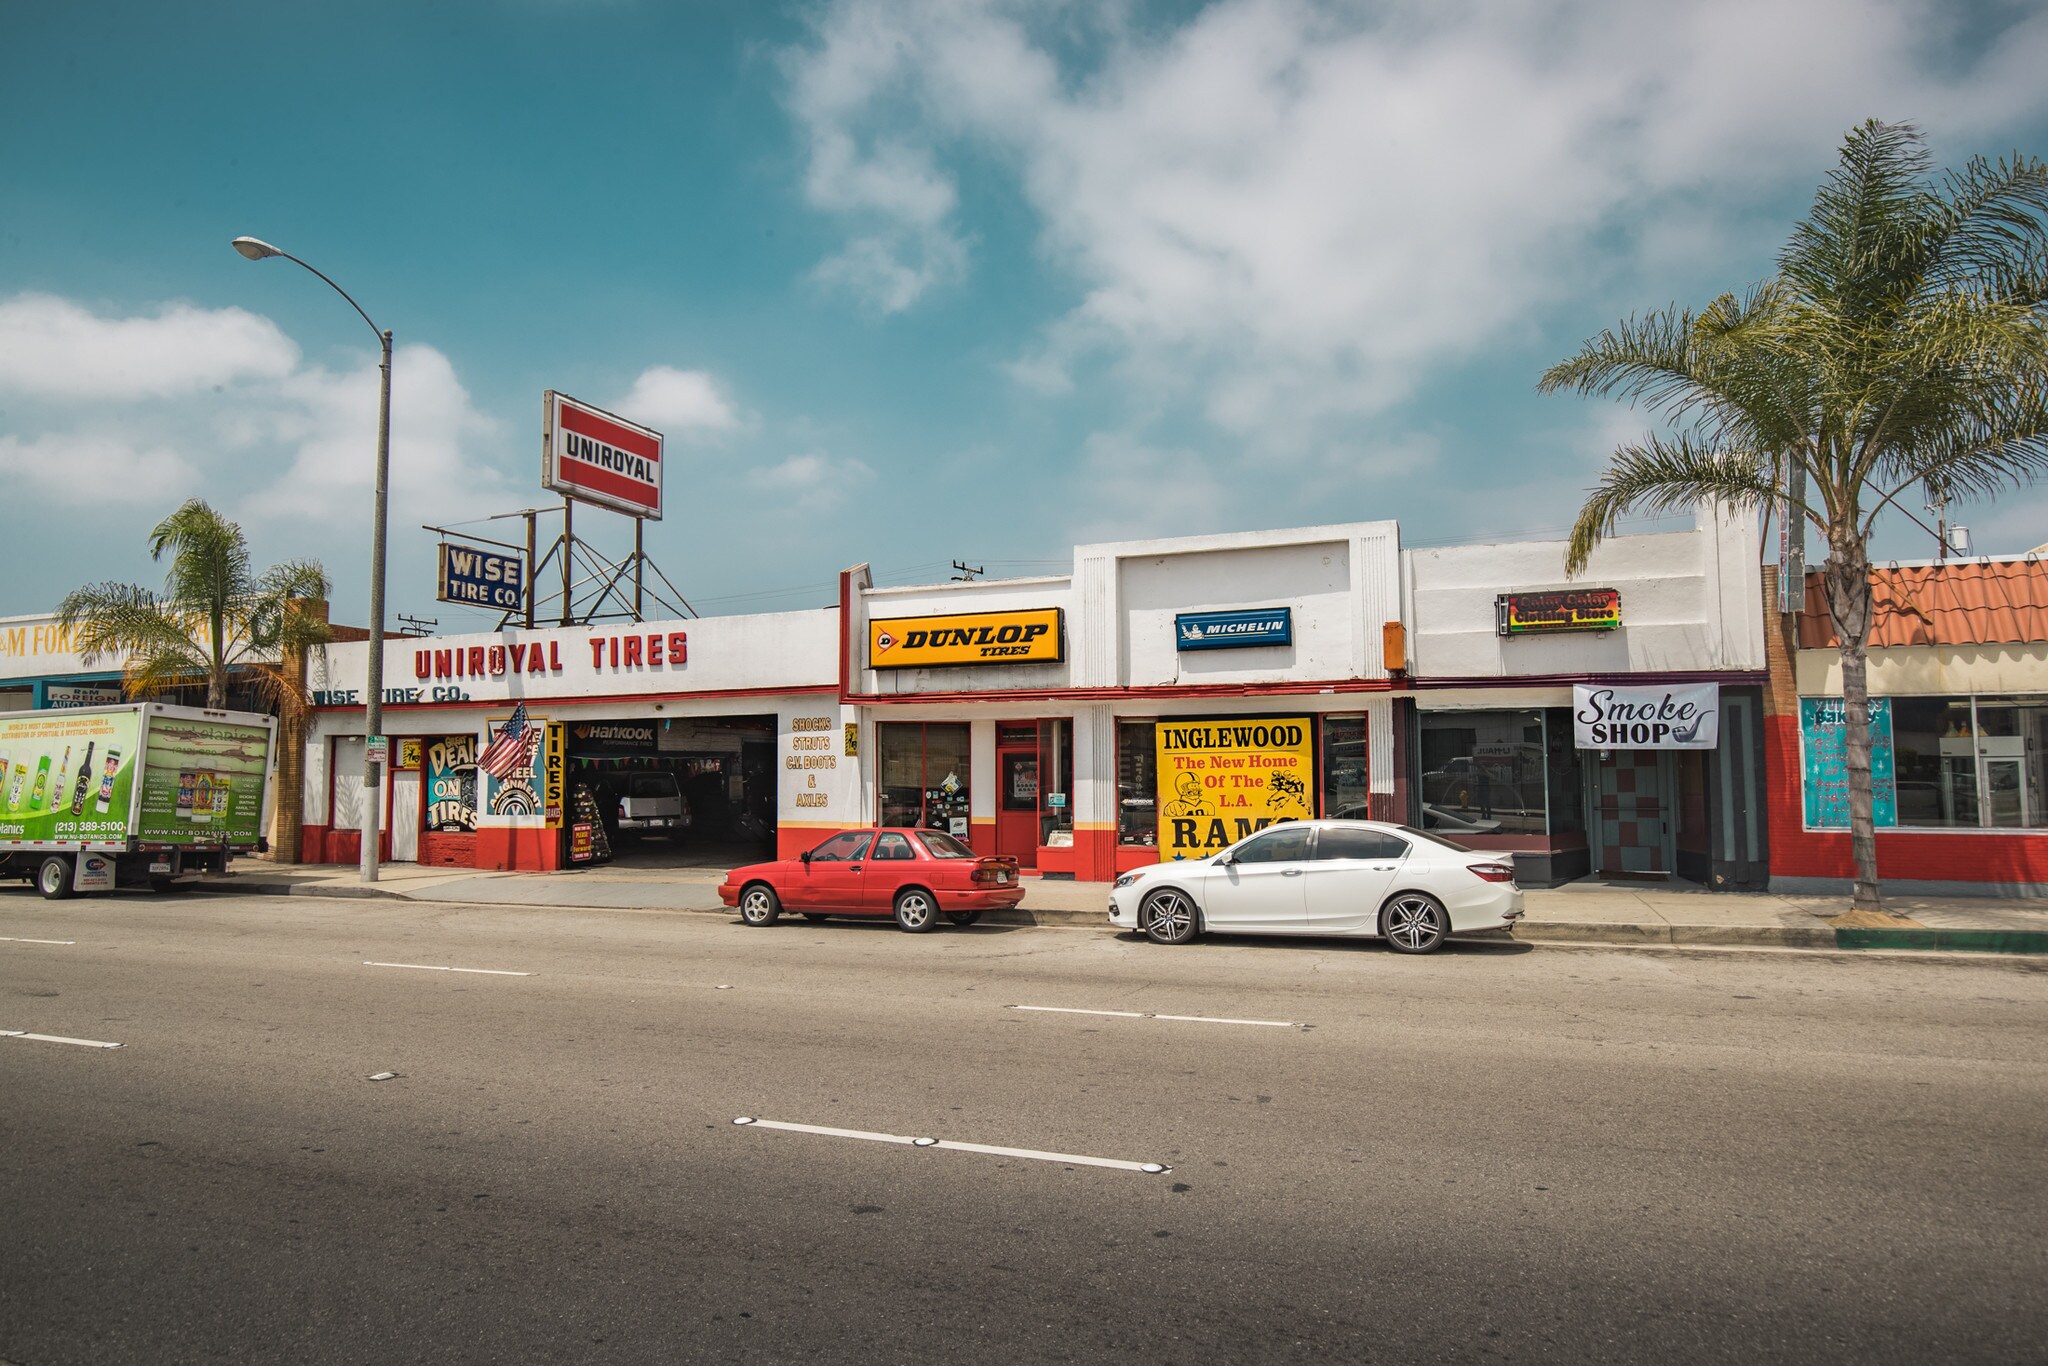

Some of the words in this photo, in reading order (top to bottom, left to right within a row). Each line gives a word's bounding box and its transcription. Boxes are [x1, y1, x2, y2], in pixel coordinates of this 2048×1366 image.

[566, 432, 655, 484] UNIROYAL
[450, 549, 518, 586] WISE
[450, 579, 489, 602] TIRE
[1514, 610, 1574, 624] Clothing
[1576, 608, 1615, 620] Store
[1206, 620, 1284, 635] MICHELIN
[902, 623, 1049, 649] DUNLOP
[415, 640, 562, 679] UNIROYAL
[588, 631, 688, 668] TIRES
[980, 645, 1032, 657] TIRES
[51, 693, 117, 702] FOREIGN
[73, 688, 100, 696] R&M
[313, 689, 359, 705] WISE
[382, 687, 418, 703] IRE
[51, 701, 80, 709] AUTO
[1577, 689, 1697, 725] Smoke
[89, 727, 115, 735] PRODUCTS
[792, 717, 832, 732] SHOCKS
[1163, 725, 1303, 750] INGLEWOOD
[1591, 723, 1670, 744] SHOP
[792, 736, 831, 751] STRUTS
[548, 724, 562, 800] TIRES
[786, 755, 803, 770] C.V.
[803, 754, 837, 769] BOOTS
[1174, 756, 1206, 769] The
[1210, 755, 1245, 769] New
[1248, 755, 1298, 768] Home
[434, 780, 461, 798] ON
[807, 774, 817, 788] &
[1204, 775, 1226, 789] Of
[1231, 775, 1264, 788] The
[489, 779, 543, 809] ALIGNMENT
[796, 793, 828, 807] AXLES
[1219, 794, 1253, 808] L.A.
[428, 801, 478, 829] TIRES
[0, 822, 25, 835] tanics
[54, 821, 77, 833] (213)
[79, 821, 124, 832] 389-5100
[1171, 816, 1299, 849] RAM
